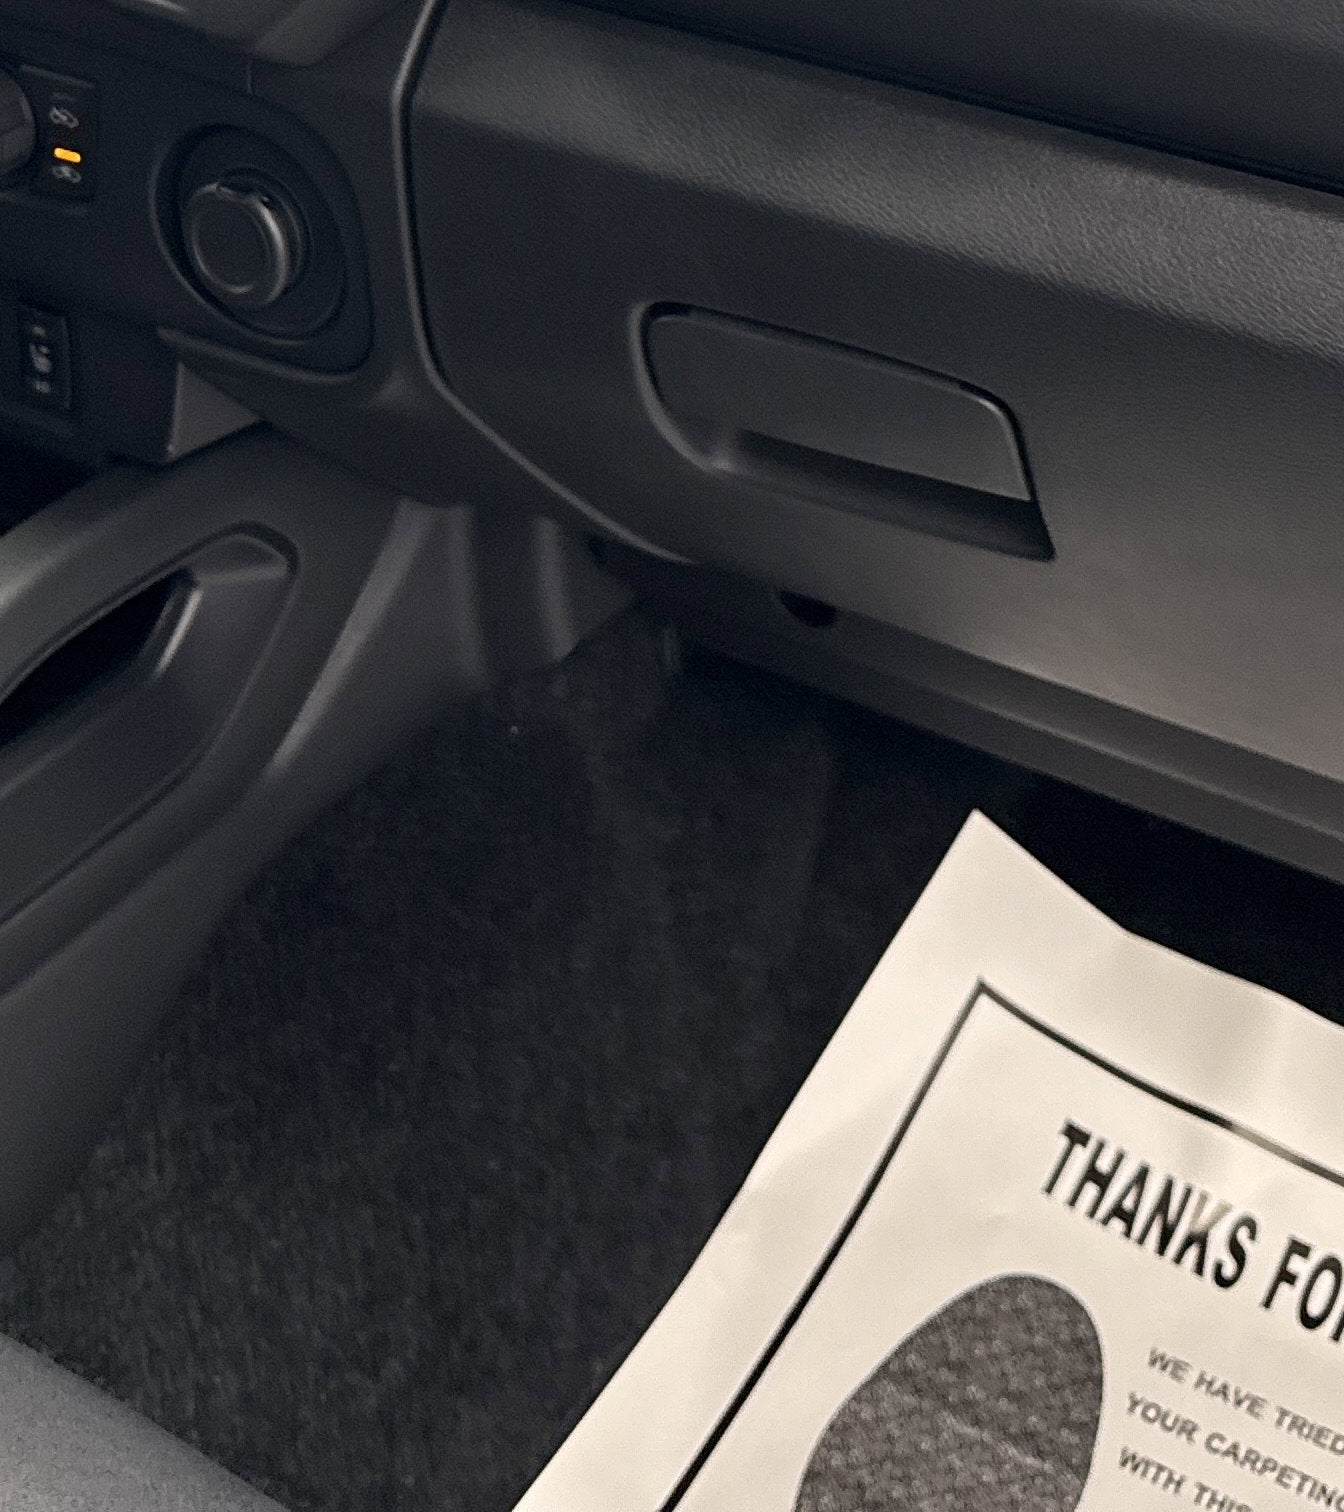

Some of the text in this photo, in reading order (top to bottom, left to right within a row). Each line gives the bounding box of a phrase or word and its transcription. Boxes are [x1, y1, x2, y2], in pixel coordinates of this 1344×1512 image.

[1041, 1118, 1258, 1288] THANKS
[1148, 1346, 1192, 1383] WE
[1194, 1370, 1268, 1421] HAVE
[1126, 1391, 1200, 1444] YOUR
[1118, 1445, 1188, 1496] WITH
